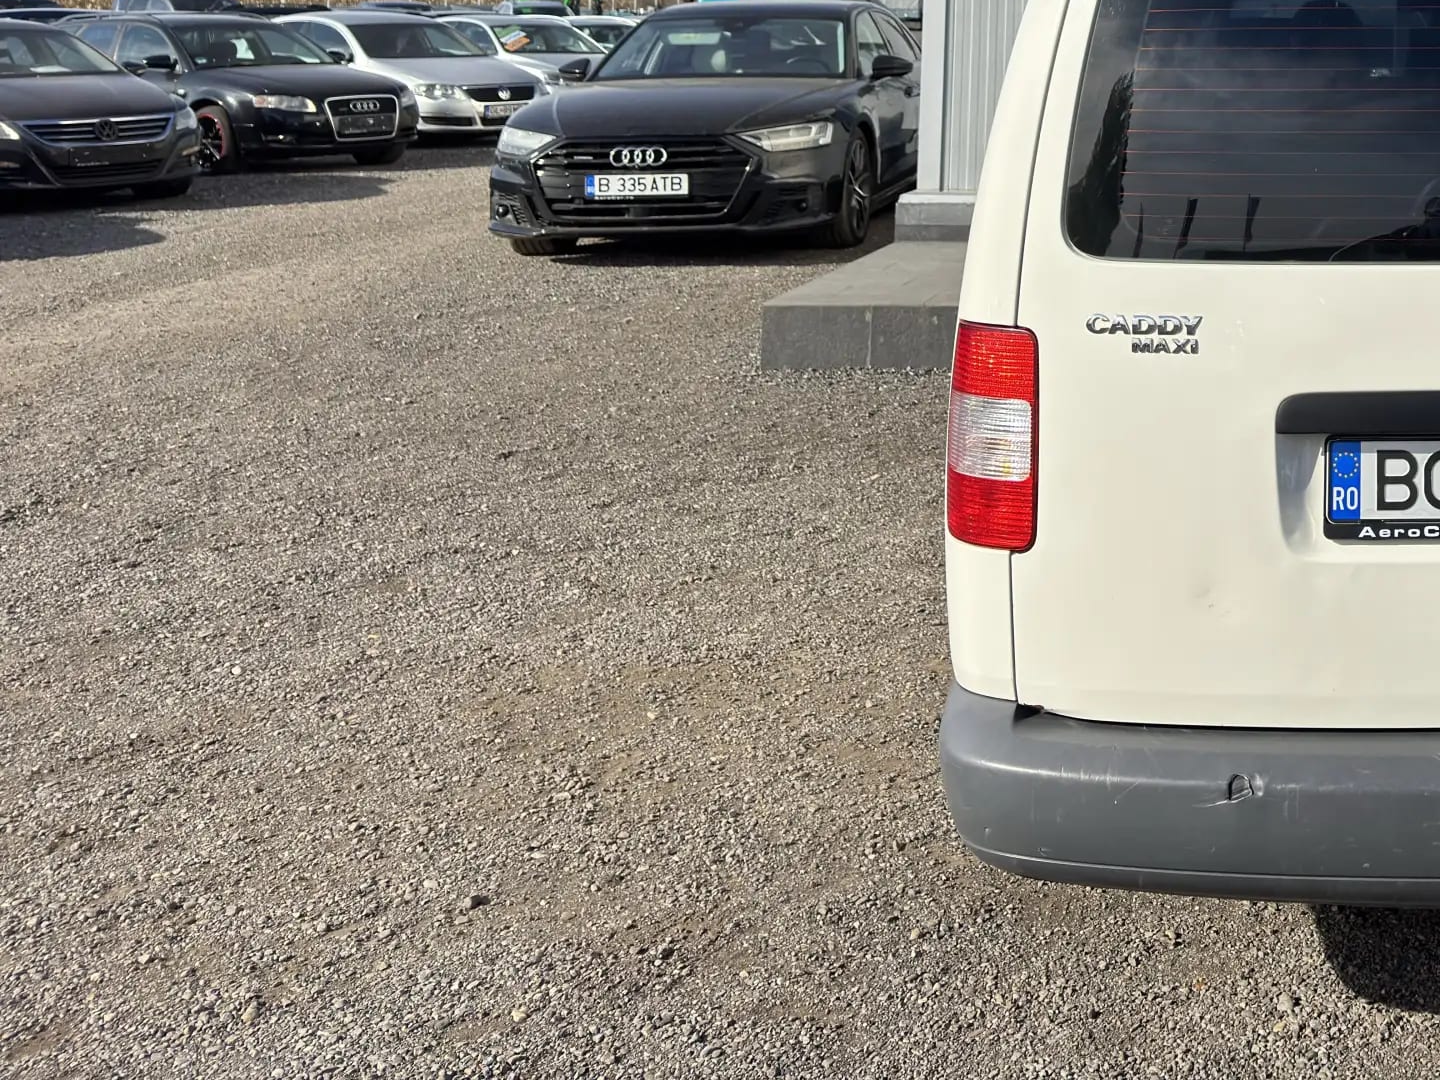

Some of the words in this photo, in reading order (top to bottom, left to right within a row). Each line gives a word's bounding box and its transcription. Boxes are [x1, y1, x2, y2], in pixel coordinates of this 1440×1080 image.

[1086, 313, 1203, 336] CADDY
[1132, 336, 1200, 355] MAXI
[1332, 486, 1359, 511] RO
